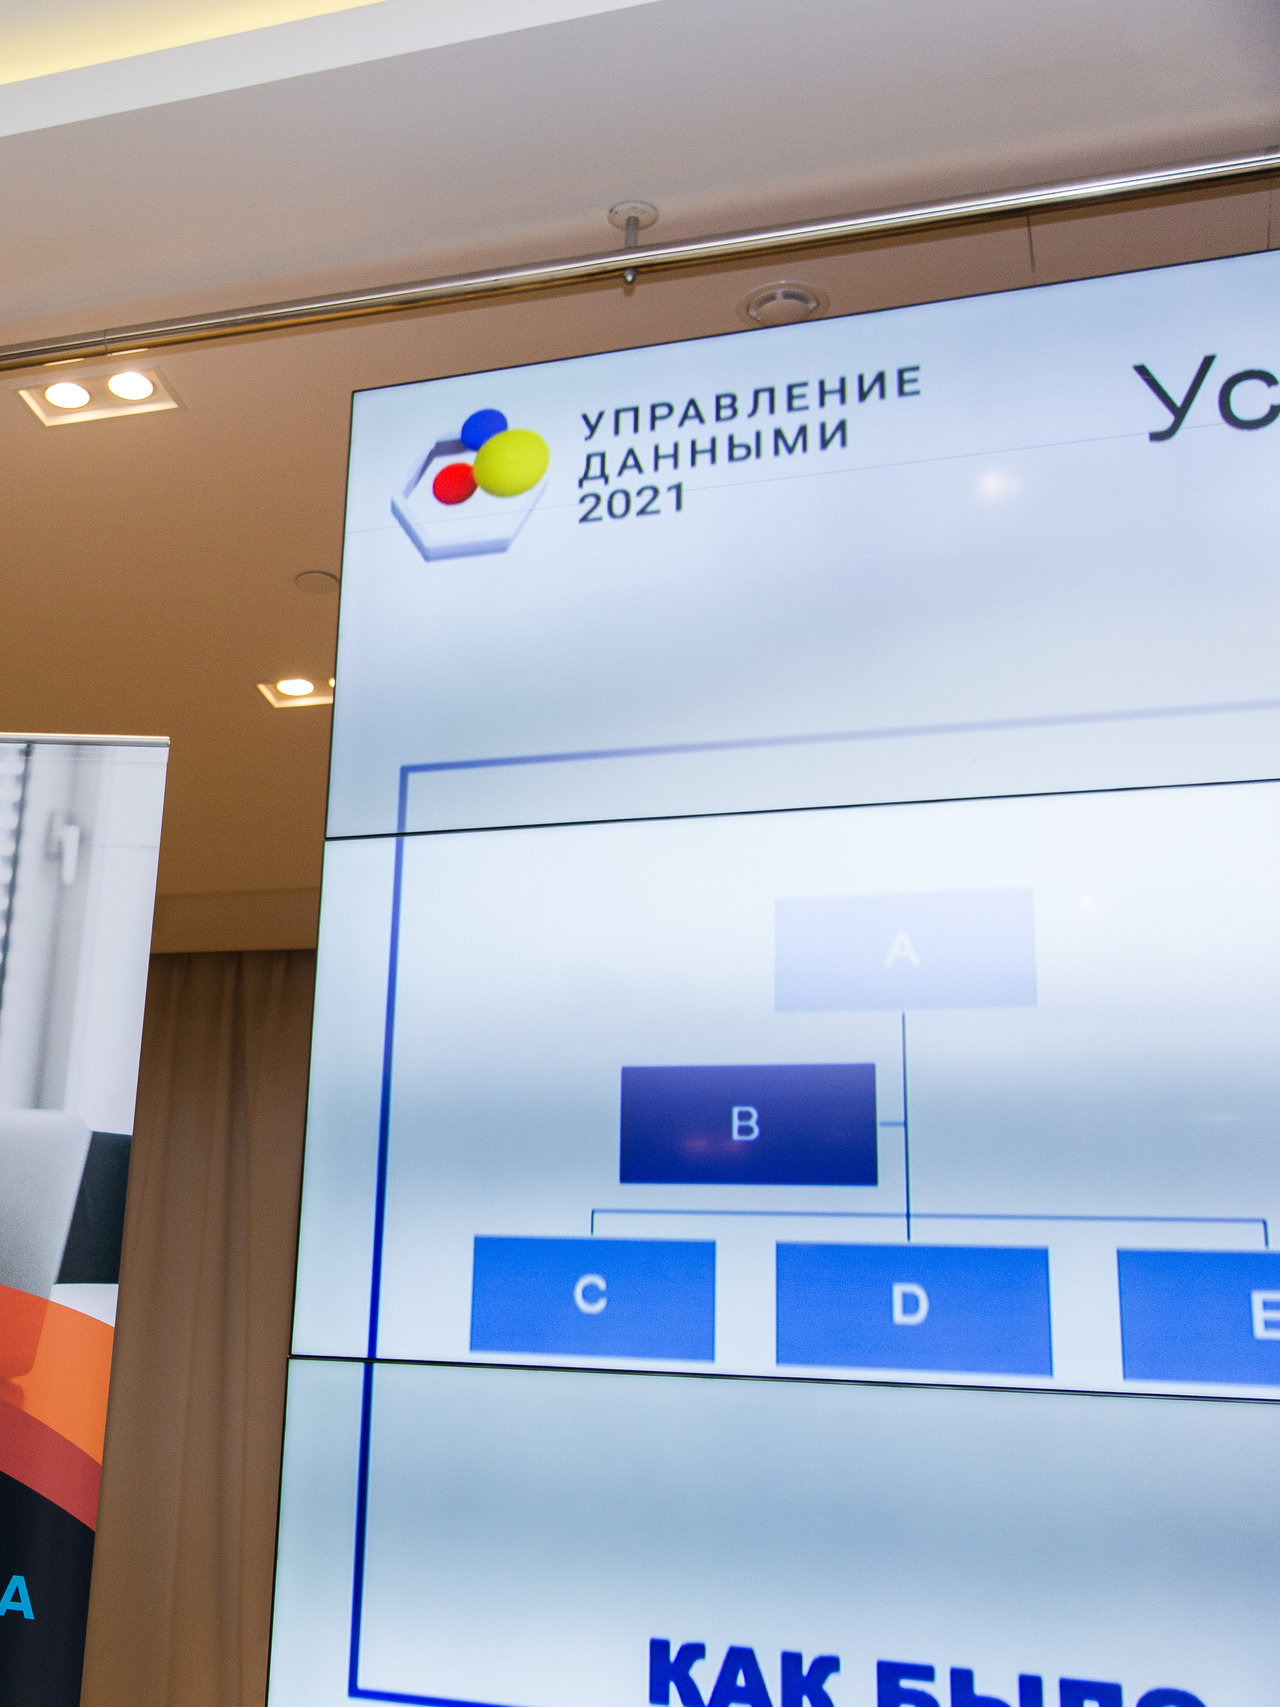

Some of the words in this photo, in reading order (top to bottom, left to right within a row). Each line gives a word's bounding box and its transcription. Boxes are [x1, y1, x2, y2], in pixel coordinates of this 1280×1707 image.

[580, 364, 921, 442] УПРАВЛЕНИЕ
[1132, 353, 1280, 442] Ус
[577, 418, 849, 489] ДАННЫМИ
[577, 482, 684, 524] 2021
[884, 930, 921, 968] A
[731, 1105, 761, 1142] B
[573, 1272, 608, 1315] C
[891, 1281, 930, 1326] D
[1251, 1288, 1280, 1341] E
[648, 1638, 842, 1707] КАК
